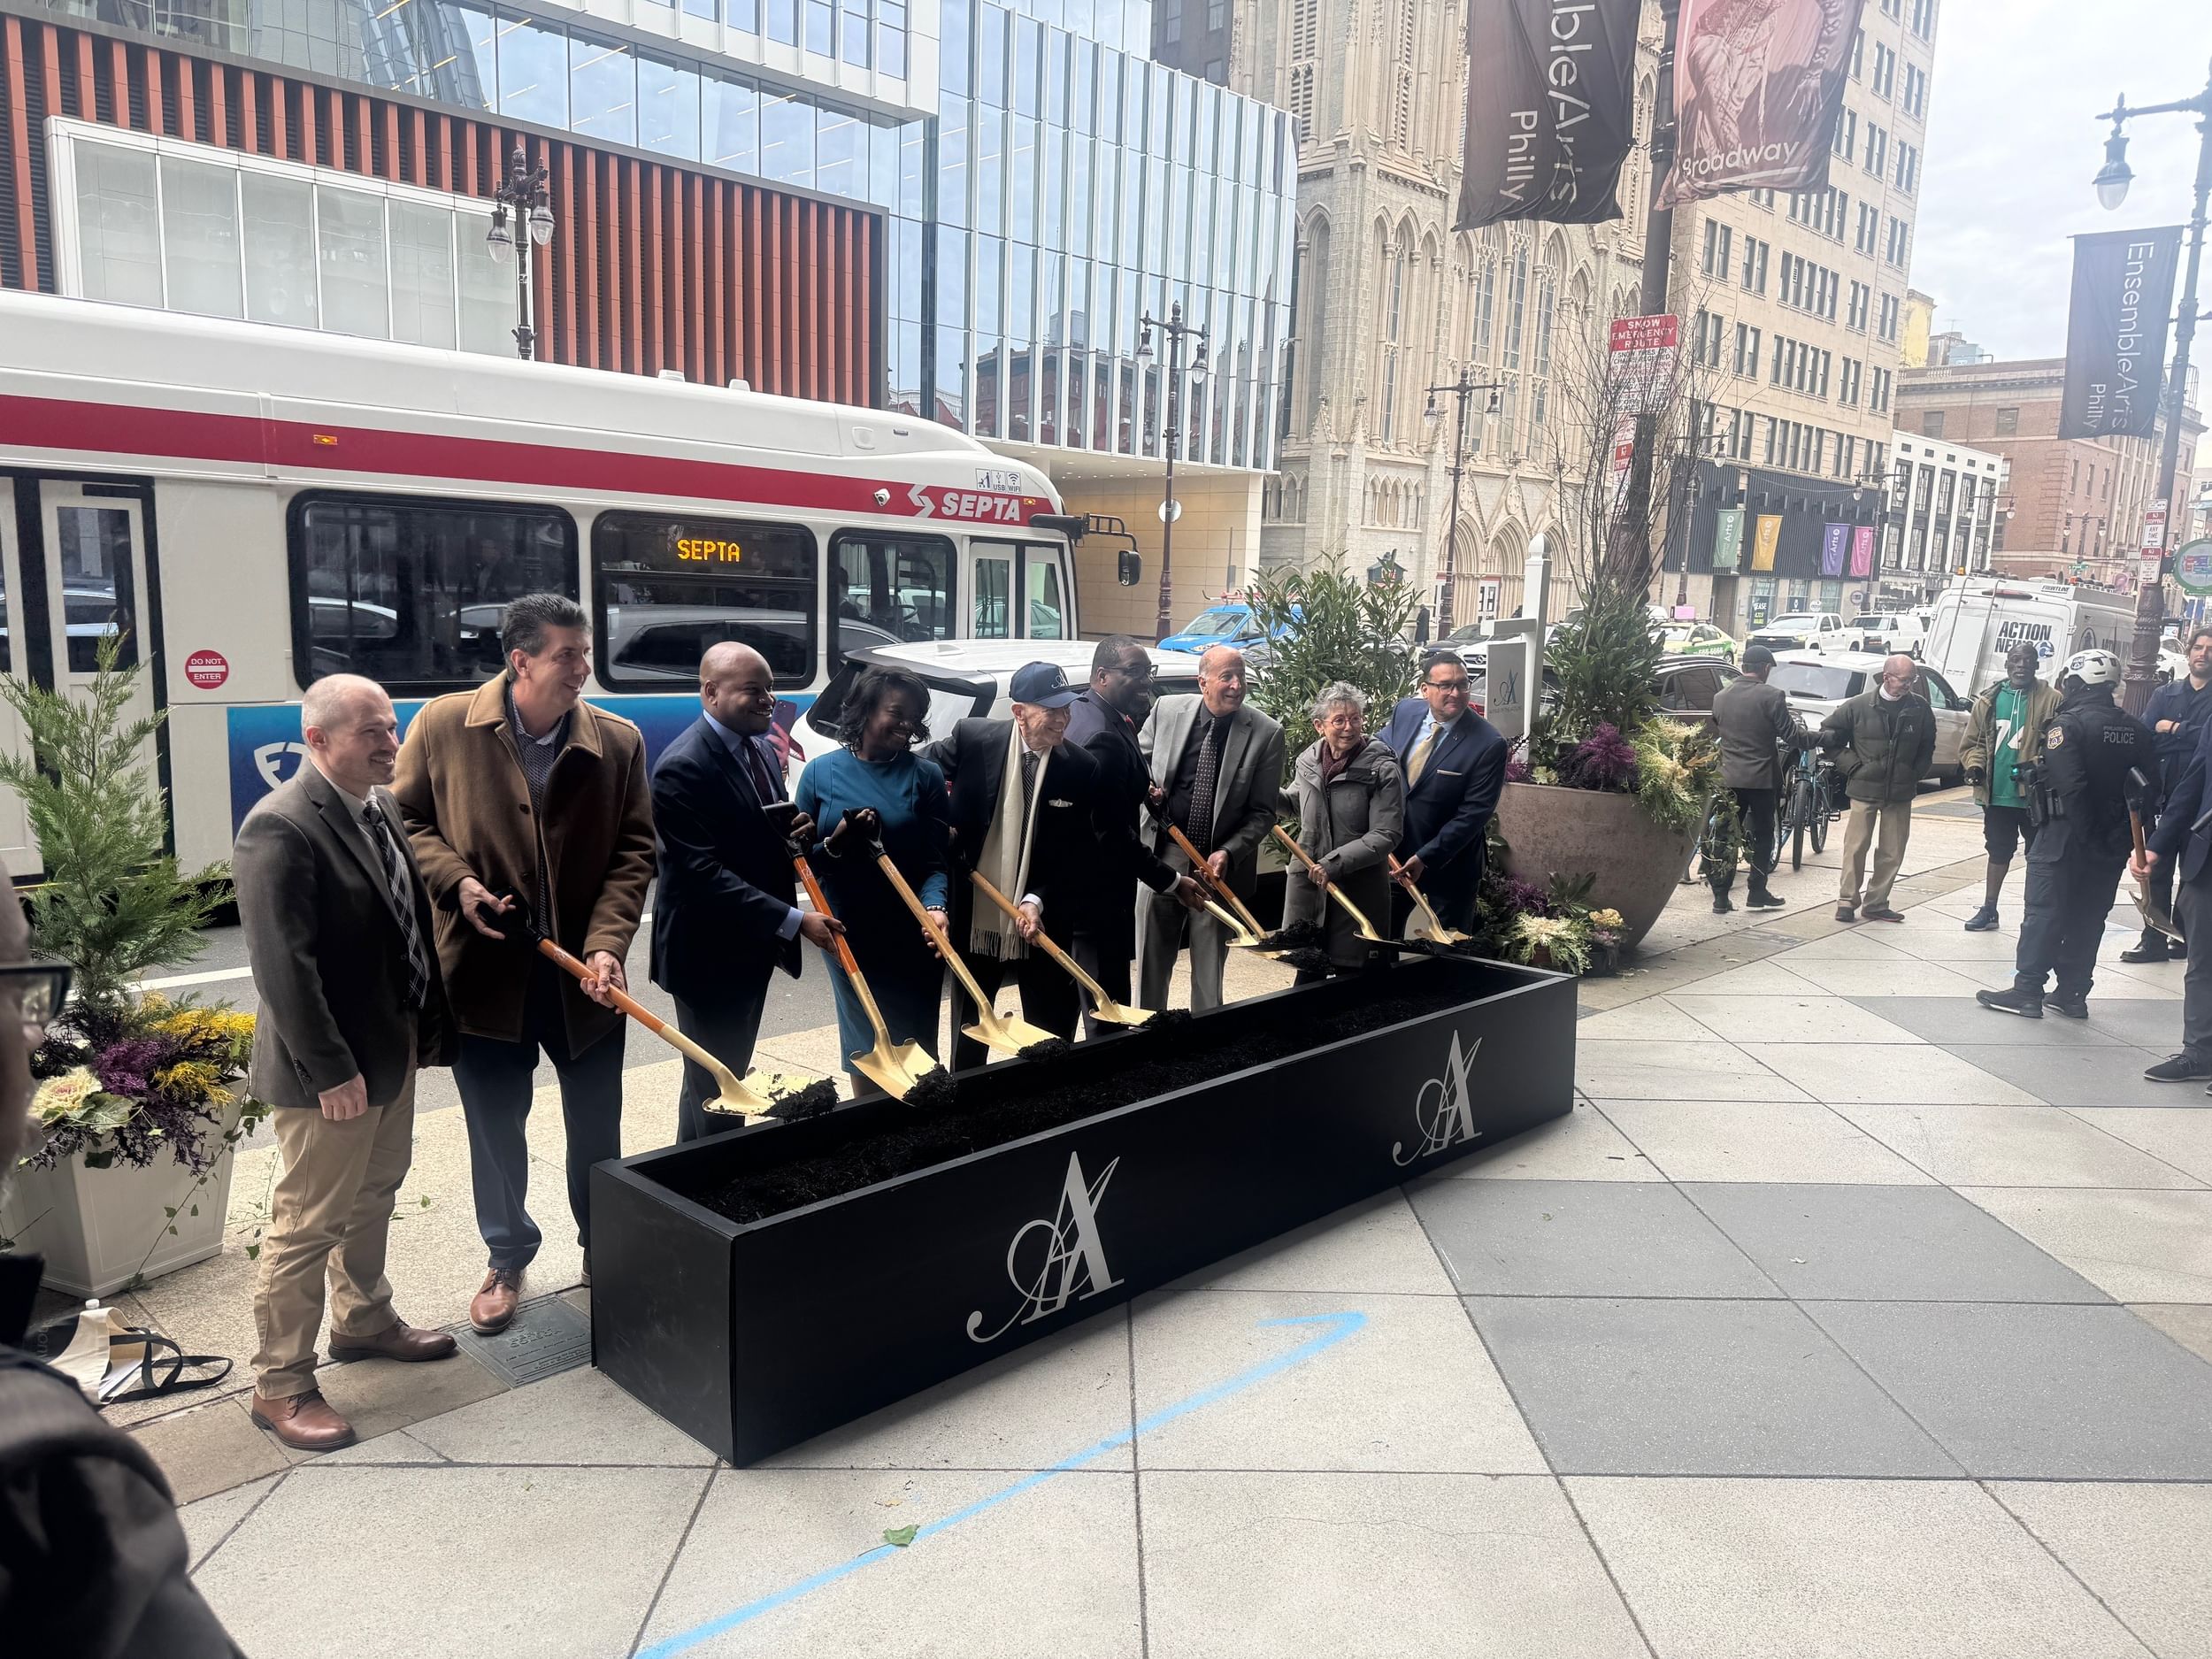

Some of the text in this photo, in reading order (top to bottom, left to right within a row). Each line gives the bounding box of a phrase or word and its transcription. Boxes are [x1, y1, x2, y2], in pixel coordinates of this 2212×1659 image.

[1548, 0, 1595, 204] bleArts
[1500, 110, 1538, 202] Philly
[1682, 141, 1800, 178] Broadway
[2111, 242, 2154, 428] EnsembleArts
[2083, 383, 2107, 428] Philly
[941, 491, 1021, 522] SEPTA
[677, 539, 740, 563] SEPTA
[1993, 637, 2034, 653] NE
[1998, 621, 2053, 641] ACTION
[2103, 731, 2135, 744] POLICE
